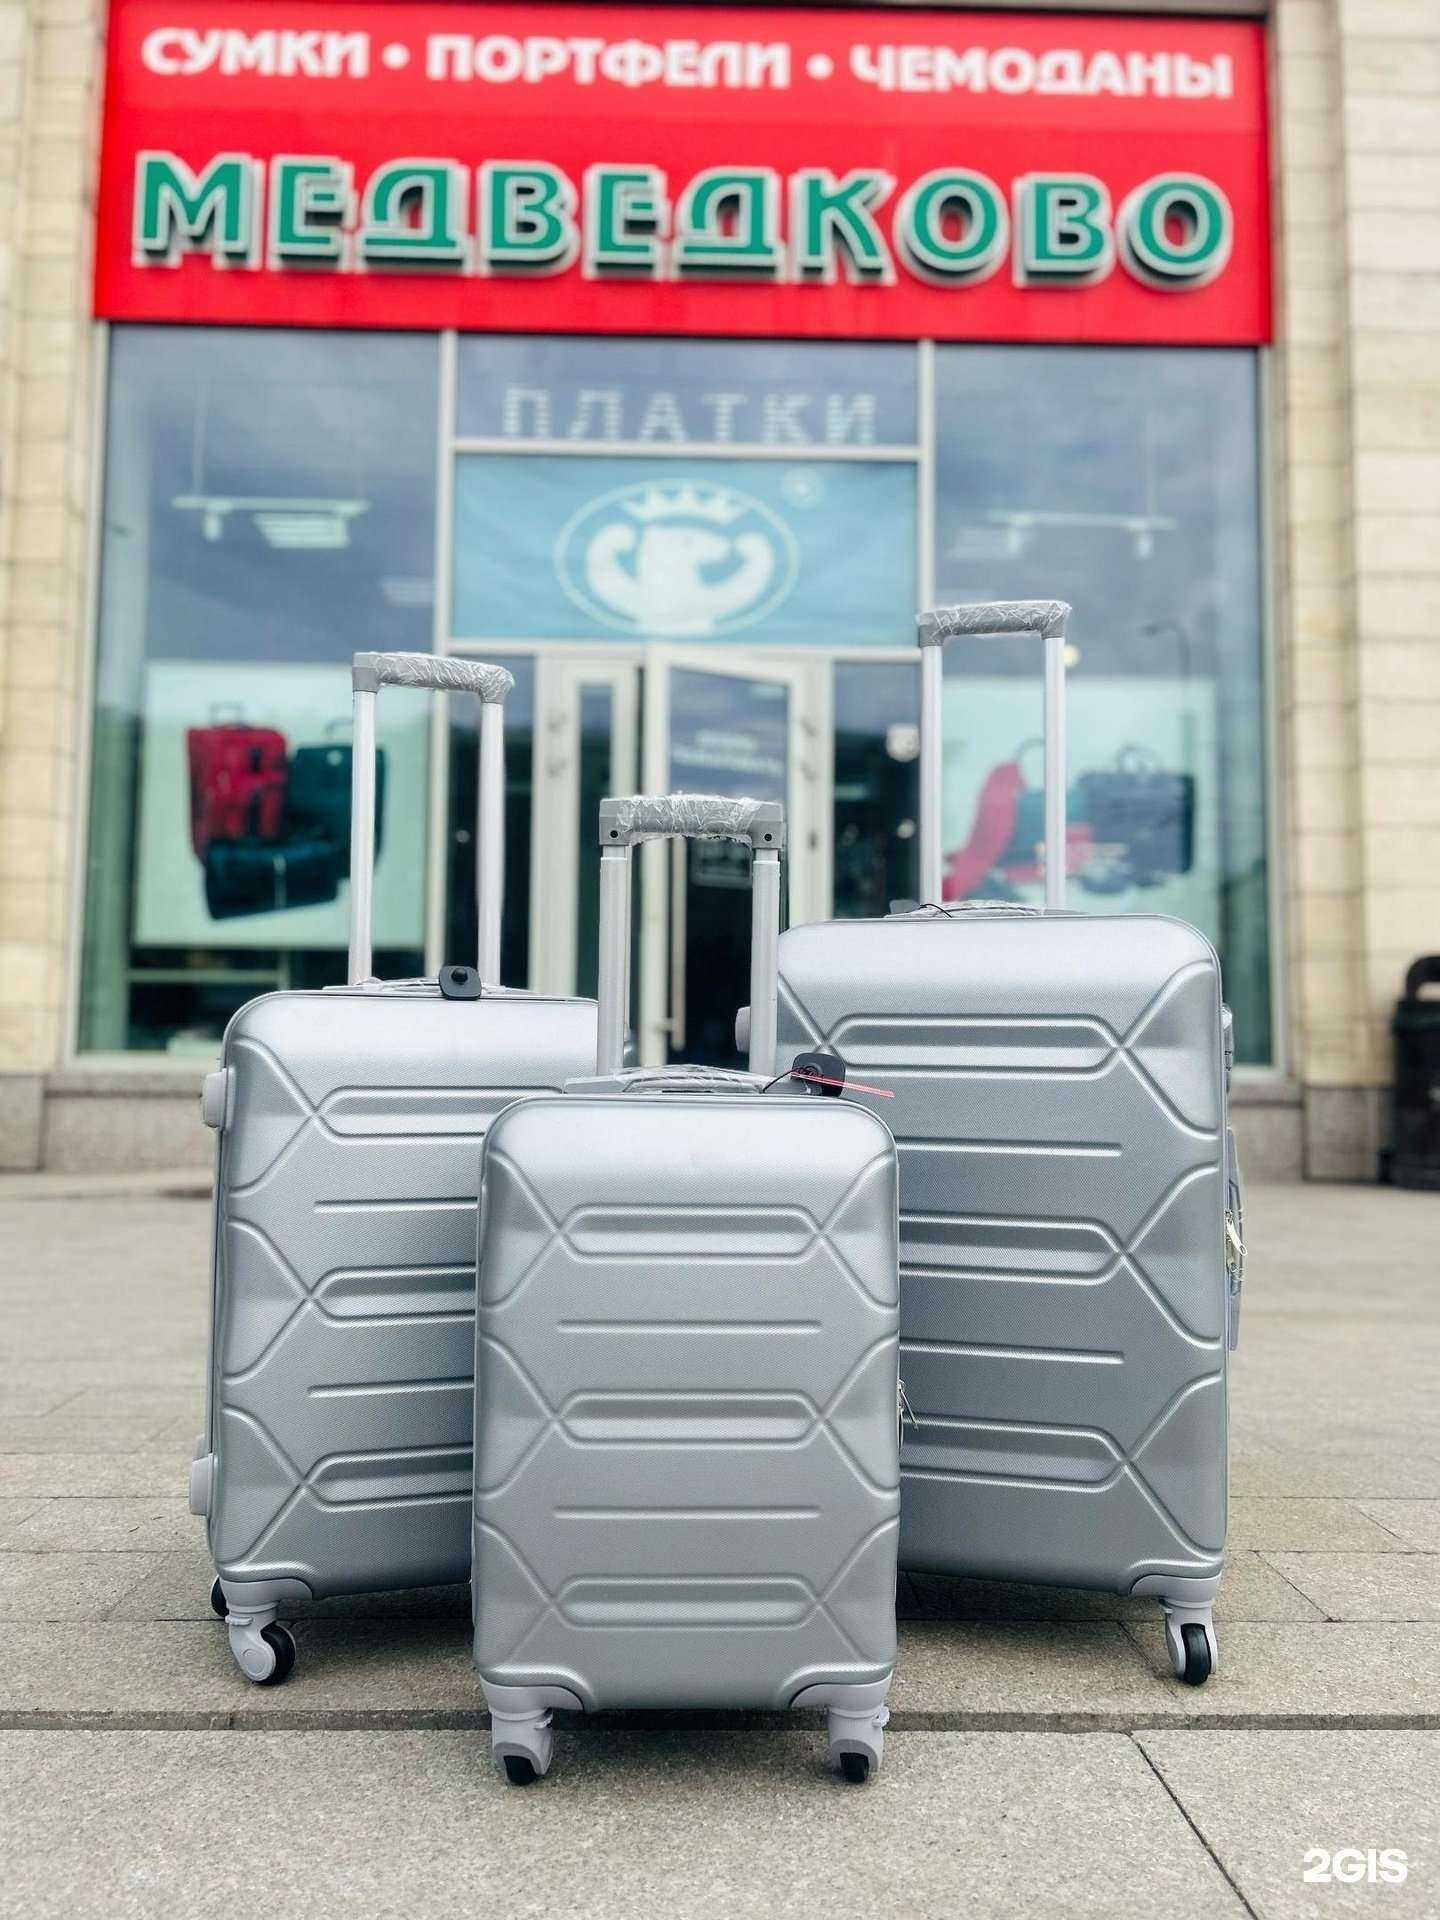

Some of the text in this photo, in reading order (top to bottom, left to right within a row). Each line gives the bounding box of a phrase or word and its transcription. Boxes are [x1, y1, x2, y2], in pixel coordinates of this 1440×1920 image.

[142, 28, 1233, 98] СУМКИ ПОРТФЕЛИ ЧЕМОДАНЫ
[132, 150, 1234, 290] МЕДВЕДКОВО
[504, 386, 876, 443] ПЛАТКИ
